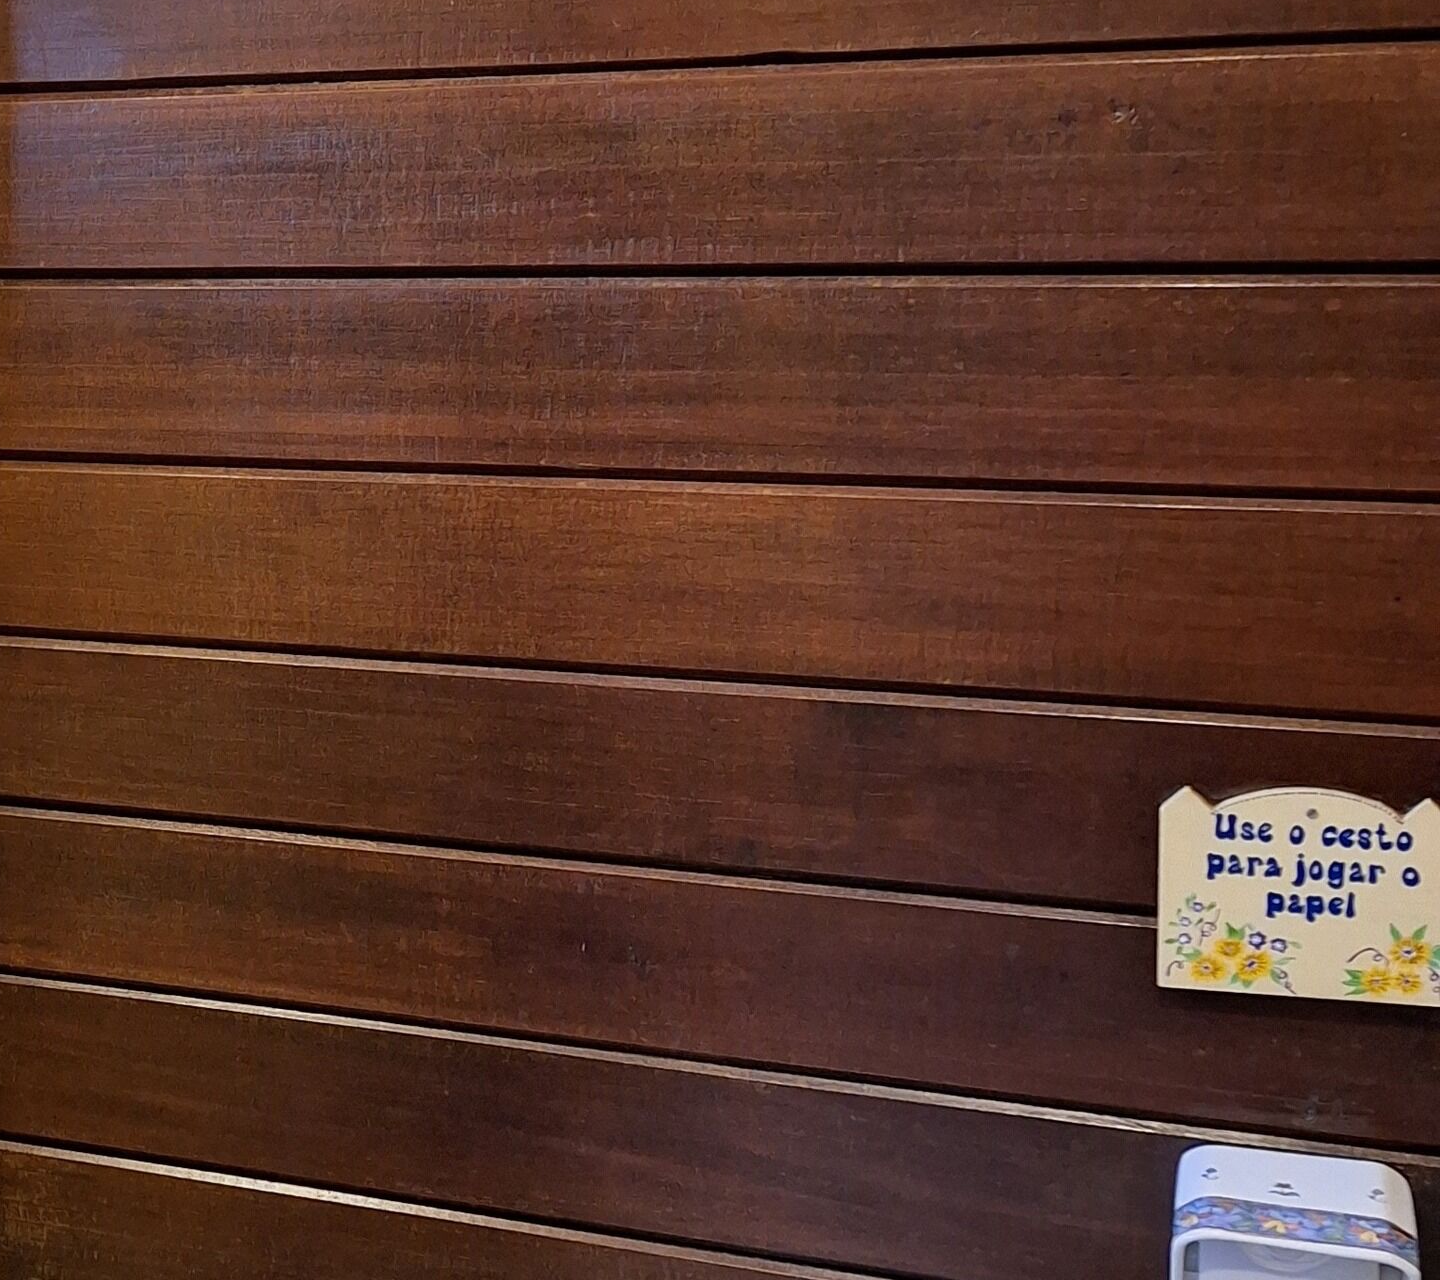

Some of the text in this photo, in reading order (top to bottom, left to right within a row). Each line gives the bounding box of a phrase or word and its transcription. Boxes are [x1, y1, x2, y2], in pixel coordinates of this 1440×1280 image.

[1215, 813, 1413, 851] Use o cesto
[1207, 853, 1420, 889] para jogar o
[1266, 891, 1356, 923] papel
